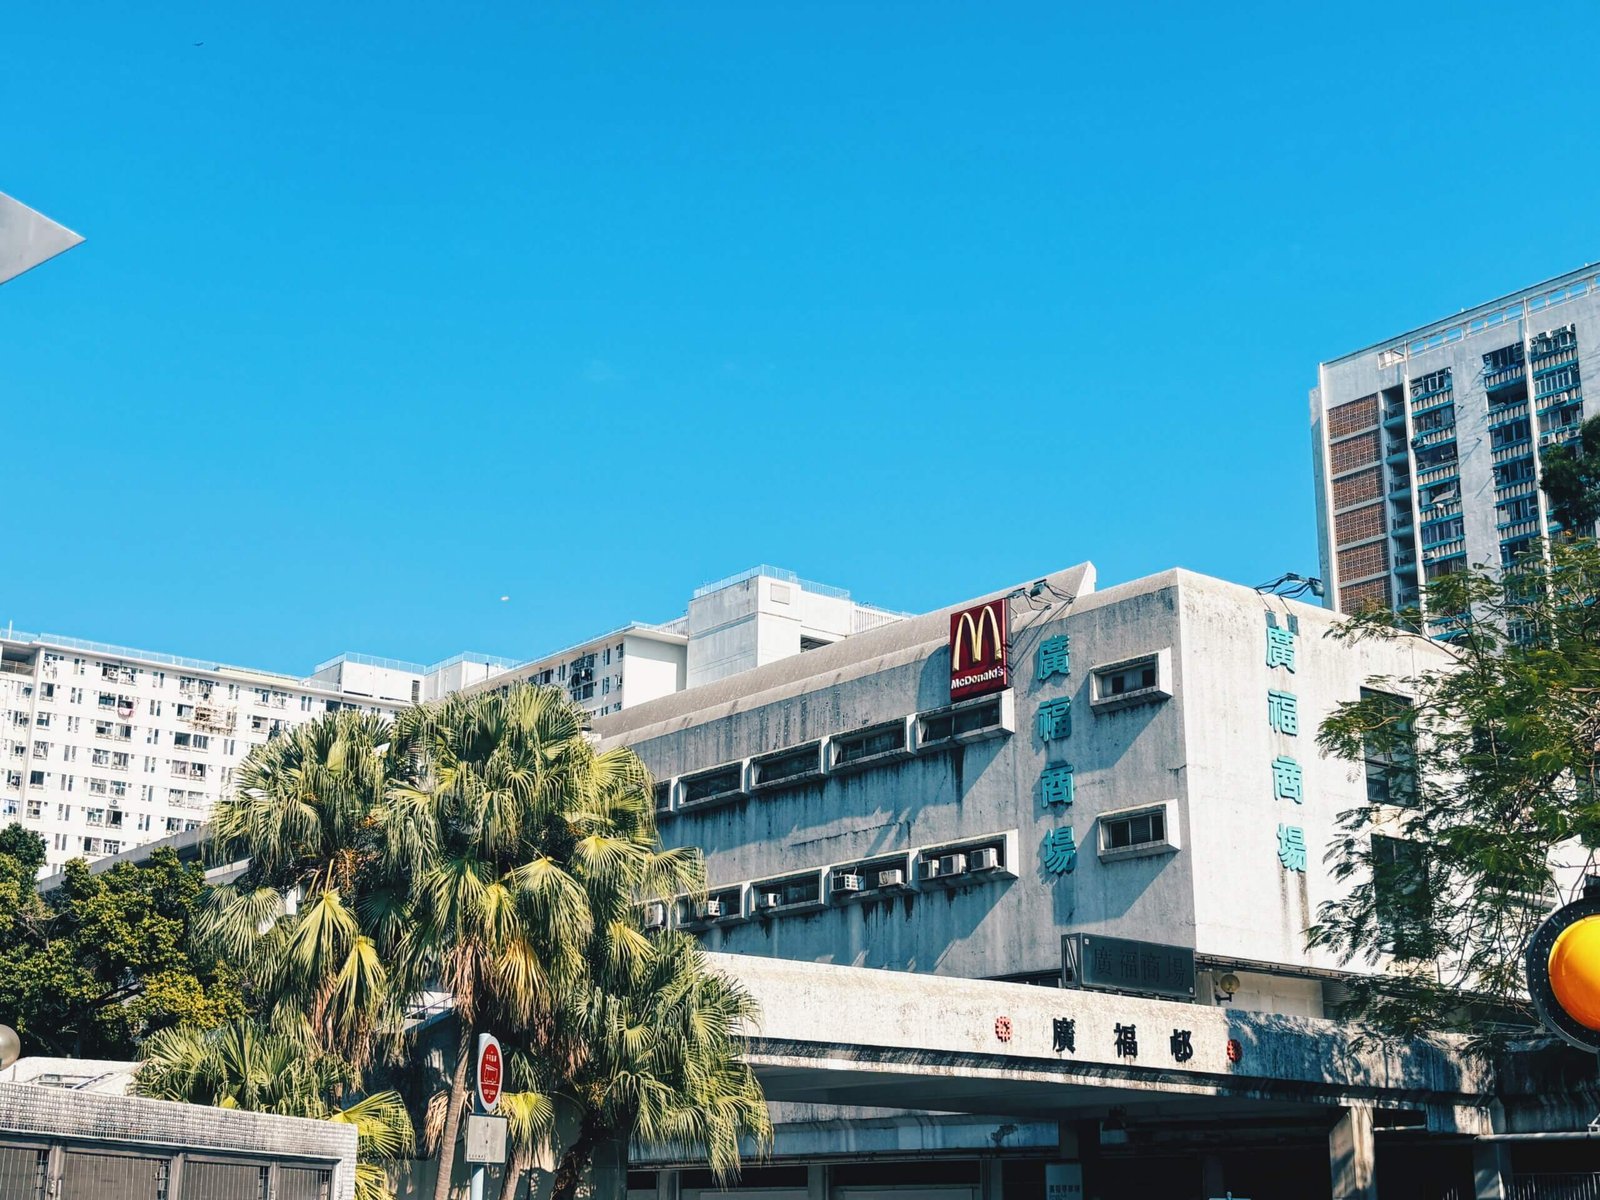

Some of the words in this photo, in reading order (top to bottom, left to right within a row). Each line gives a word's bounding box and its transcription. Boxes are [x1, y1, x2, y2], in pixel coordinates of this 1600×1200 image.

[951, 666, 1004, 689] McDonald's
[1037, 634, 1077, 875] 廣福商場
[1264, 625, 1308, 873] 廣福商場
[1094, 945, 1186, 986] 廣福商場
[1052, 1017, 1194, 1062] 廣福邨
